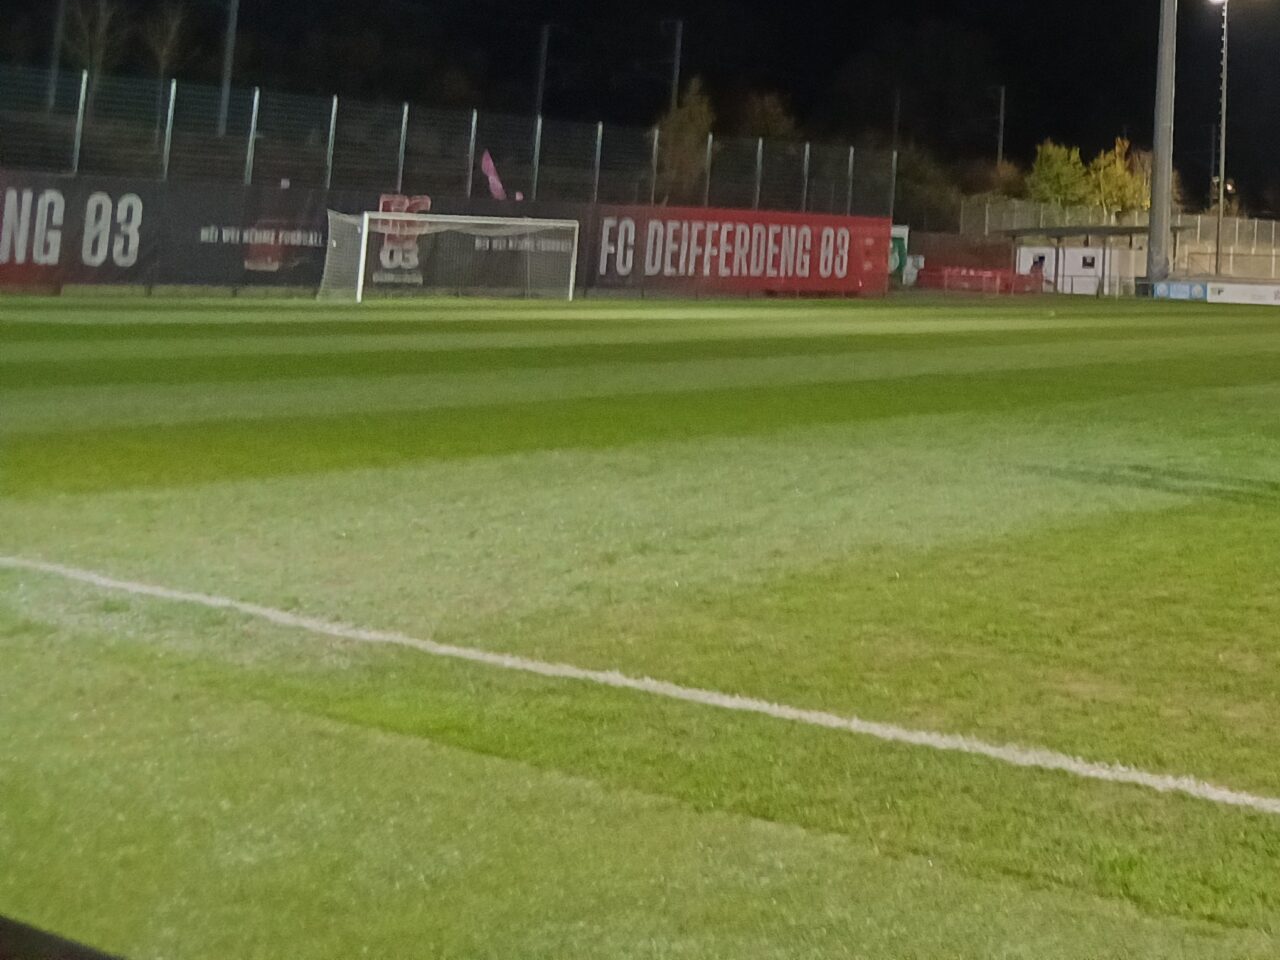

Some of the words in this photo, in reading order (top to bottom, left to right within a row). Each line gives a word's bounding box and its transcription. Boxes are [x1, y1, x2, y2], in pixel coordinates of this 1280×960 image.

[0, 187, 65, 266] NG
[82, 191, 143, 268] 03
[600, 216, 636, 276] FC
[645, 219, 812, 278] DEIFFERDENG
[819, 226, 850, 279] 03
